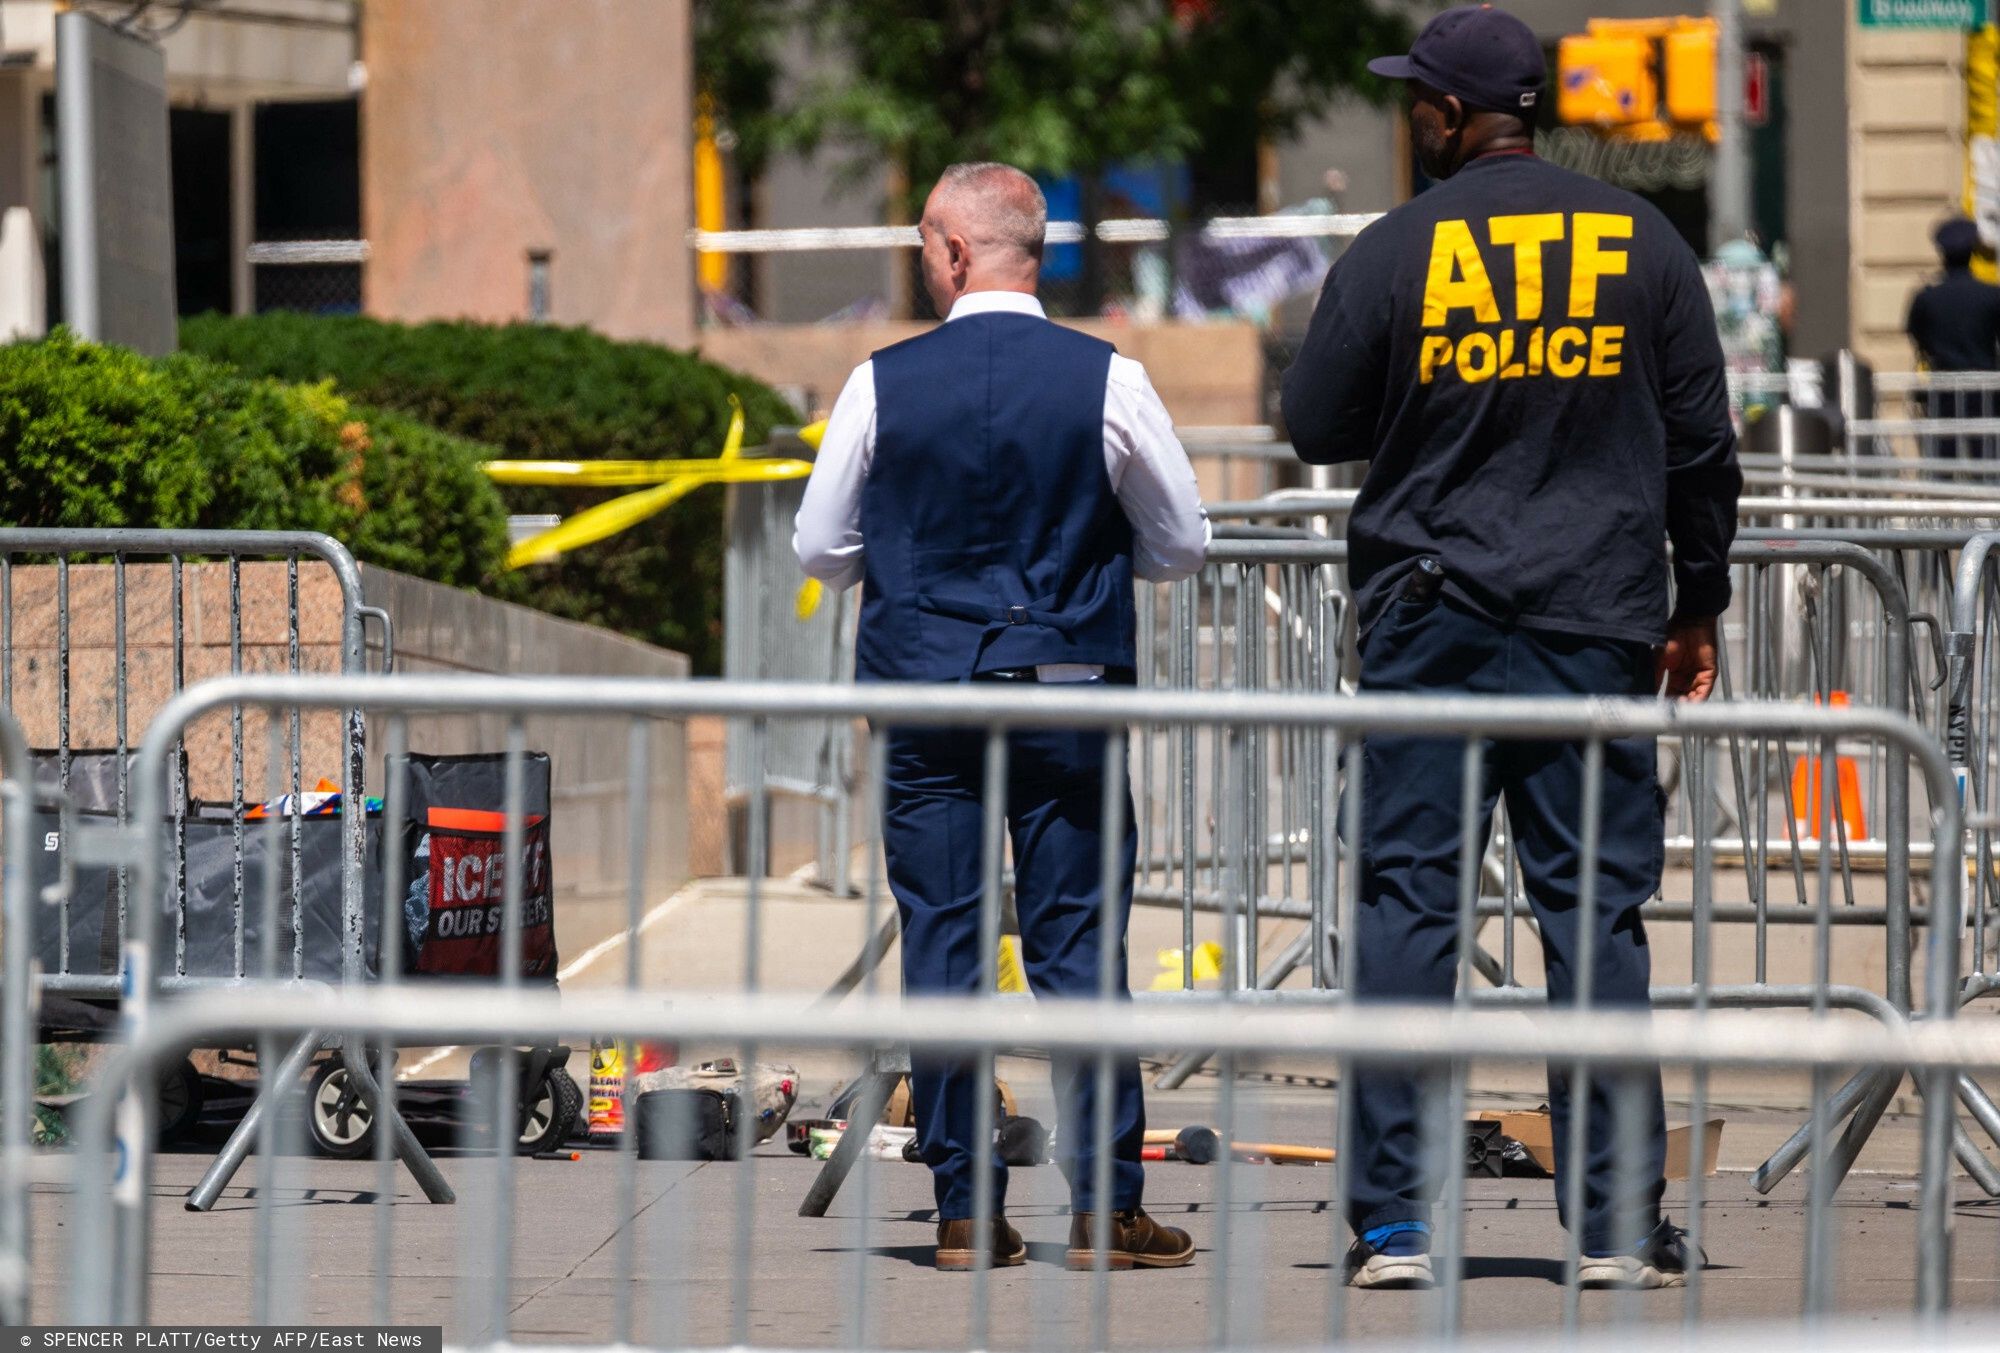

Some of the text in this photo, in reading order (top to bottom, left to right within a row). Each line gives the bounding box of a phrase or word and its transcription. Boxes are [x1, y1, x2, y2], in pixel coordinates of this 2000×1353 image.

[1421, 212, 1634, 327] ATF
[1420, 325, 1626, 385] POLICE
[443, 852, 506, 902] ICE
[437, 908, 484, 938] OUR
